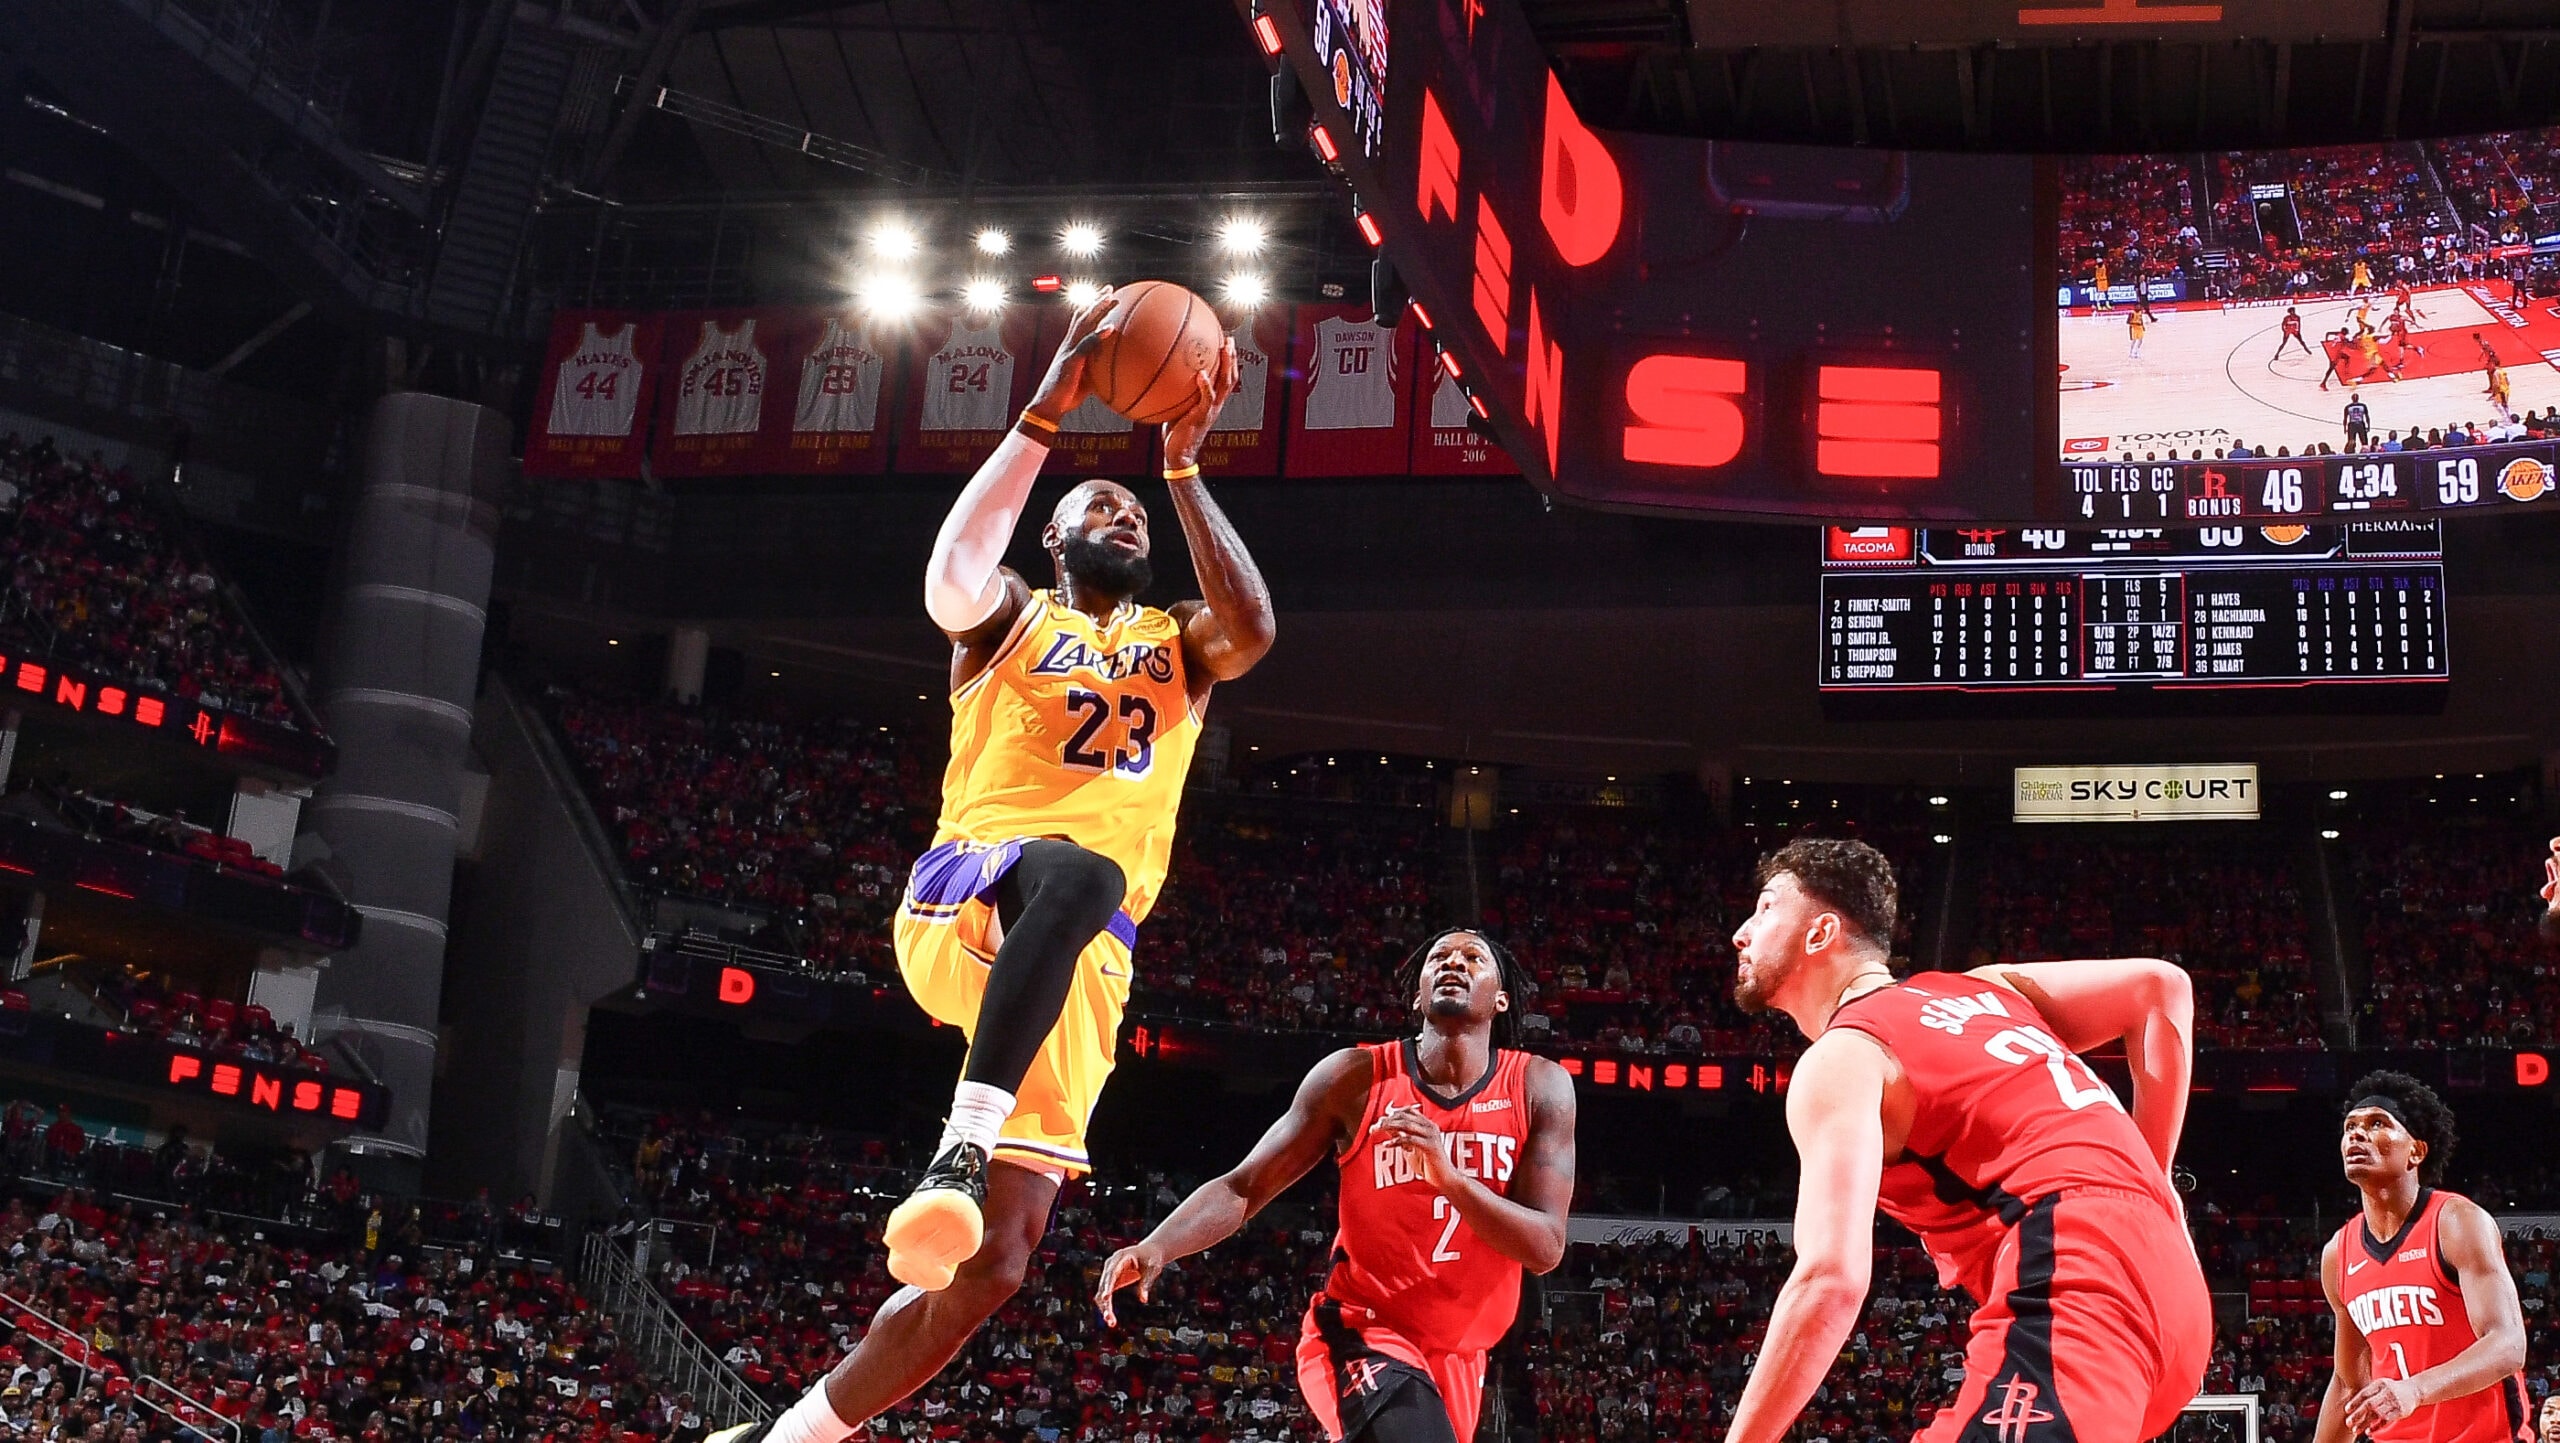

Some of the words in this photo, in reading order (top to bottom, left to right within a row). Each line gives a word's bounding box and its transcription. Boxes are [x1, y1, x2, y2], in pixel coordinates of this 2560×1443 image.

[1336, 331, 1375, 343] DAWSON
[575, 353, 631, 369] HAYES
[937, 345, 1010, 366] MALONE
[575, 371, 618, 399] 44
[703, 368, 745, 396] 45
[822, 364, 856, 394] 23
[949, 363, 991, 393] 24
[1434, 433, 1463, 446] HALL
[2117, 429, 2229, 442] TOYOTA
[2116, 438, 2230, 450] CENTER
[1462, 450, 1486, 463] 2016
[2072, 468, 2103, 492] TOL
[2111, 468, 2140, 492] FLS
[2152, 468, 2173, 491] CC
[2262, 469, 2302, 513] 46
[2340, 463, 2397, 498] 4:34
[2438, 458, 2479, 504] 59
[2082, 494, 2094, 518] 4
[2122, 494, 2130, 517] 1
[2158, 493, 2167, 516] 1
[2188, 498, 2240, 516] BONUS
[1843, 542, 1895, 553] TACOMA
[1965, 543, 1995, 556] BONUS
[2102, 580, 2106, 592] 1
[2125, 580, 2140, 592] FLS
[1835, 600, 1840, 612] 2
[1848, 599, 1910, 612] FINNEY-SMITH
[1935, 598, 1941, 610] 0
[1961, 598, 1965, 610] 1
[1985, 597, 1991, 609] 0
[2011, 597, 2015, 609] 1
[2035, 596, 2041, 609] 0
[2061, 596, 2065, 608] 1
[2101, 595, 2107, 607] 4
[2125, 595, 2141, 607] TOL
[2160, 594, 2166, 606] 7
[2197, 594, 2203, 606] 11
[2211, 593, 2240, 606] HAYES
[2325, 592, 2329, 604] 1
[2349, 592, 2355, 604] 0
[2375, 591, 2379, 603] 1
[2399, 591, 2406, 603] 0
[2424, 590, 2431, 602] 2
[1934, 614, 1942, 627] 11
[1985, 614, 1991, 626] 3
[2011, 613, 2015, 626] 1
[2035, 613, 2041, 625] 0
[2060, 612, 2066, 625] 0
[2102, 610, 2106, 622] 1
[2127, 610, 2139, 622] CC
[2161, 609, 2165, 621] 1
[2195, 611, 2206, 623] 28
[2212, 609, 2265, 622] HACHIMURA
[2325, 608, 2329, 621] 1
[2351, 608, 2354, 620] 1
[2376, 607, 2380, 620] 1
[2400, 607, 2406, 619] 0
[2426, 607, 2430, 619] 1
[1832, 633, 1841, 645] 10
[1848, 632, 1876, 645] SMITH
[1933, 631, 1943, 643] 12
[1960, 631, 1966, 643] 2
[1985, 630, 1991, 643] 0
[2010, 630, 2016, 642] 0
[2035, 629, 2041, 642] 0
[2128, 626, 2139, 638] 2P
[2151, 624, 2175, 638] 14/21
[2196, 627, 2205, 639] 10
[2212, 626, 2253, 639] KENNARD
[2299, 625, 2306, 637] 8
[2326, 625, 2330, 637] 1
[2350, 624, 2356, 636] 4
[2375, 624, 2382, 636] 0
[2401, 624, 2407, 636] 0
[2427, 623, 2431, 635] 1
[1835, 650, 1838, 662] 1
[1848, 648, 1896, 661] THOMPSON
[1935, 647, 1940, 660] 7
[1985, 647, 1991, 659] 2
[2010, 646, 2016, 659] 0
[2035, 646, 2042, 659] 2
[2061, 645, 2067, 658] 0
[2128, 641, 2139, 653] 3P
[2196, 644, 2207, 656] 23
[2213, 643, 2242, 656] JAMES
[2298, 642, 2308, 654] 14
[2351, 641, 2357, 653] 4
[2377, 641, 2381, 653] 1
[2402, 640, 2408, 652] 0
[2428, 640, 2432, 652] 1
[1028, 630, 1174, 684] LAKERS
[2129, 656, 2138, 668] FT
[2213, 659, 2244, 672] SMART
[2300, 658, 2307, 671] 3
[2326, 658, 2332, 671] 2
[2377, 657, 2383, 670] 2
[2403, 657, 2407, 669] 1
[2427, 656, 2434, 669] 0
[1832, 666, 1840, 678] 15
[1847, 665, 1893, 678] SHEPPARD
[1960, 664, 1966, 677] 0
[1985, 664, 1991, 676] 3
[2010, 663, 2016, 676] 0
[2036, 663, 2042, 675] 0
[2061, 662, 2067, 675] 0
[0, 655, 165, 728] ENSE
[1061, 686, 1158, 782] 23
[2070, 780, 2137, 800] SKY
[720, 967, 755, 1003] D
[2517, 1053, 2549, 1086] D
[169, 1054, 361, 1120] FENSE
[1374, 1132, 1516, 1190] ROKETS
[1432, 1196, 1461, 1263] 2
[2346, 1286, 2444, 1335] ROCKETS
[2390, 1343, 2410, 1381] 1
